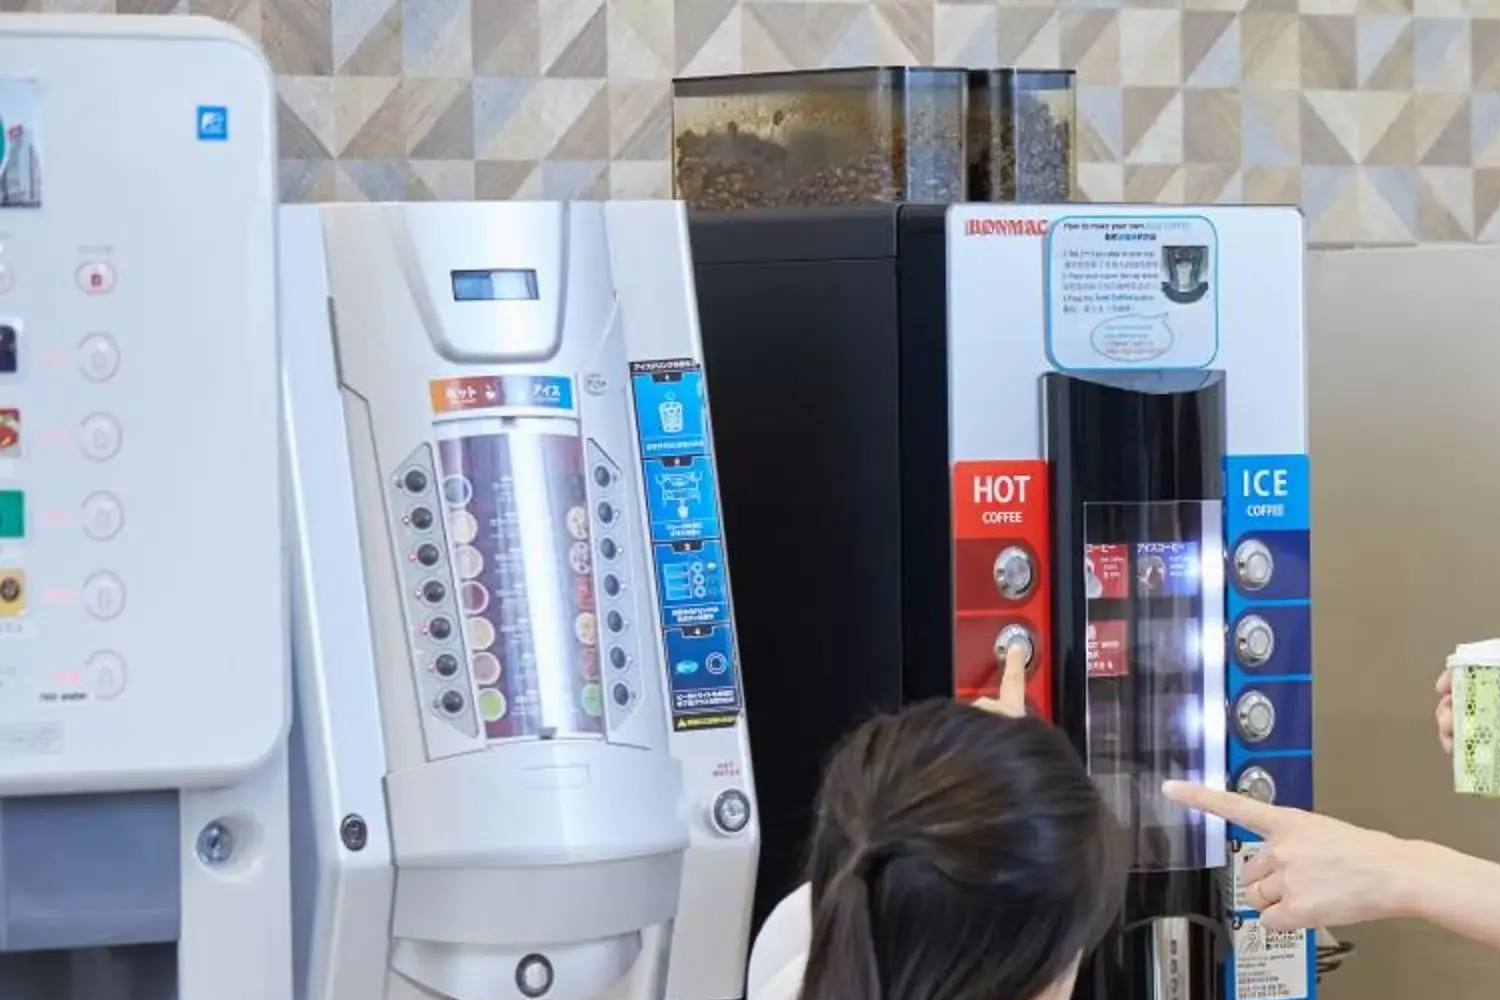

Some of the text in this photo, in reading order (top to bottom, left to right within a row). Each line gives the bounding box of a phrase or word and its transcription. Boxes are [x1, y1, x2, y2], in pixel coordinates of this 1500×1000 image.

[973, 475, 1031, 503] HOT
[1242, 469, 1288, 497] ICE
[981, 511, 1023, 524] COFFEE
